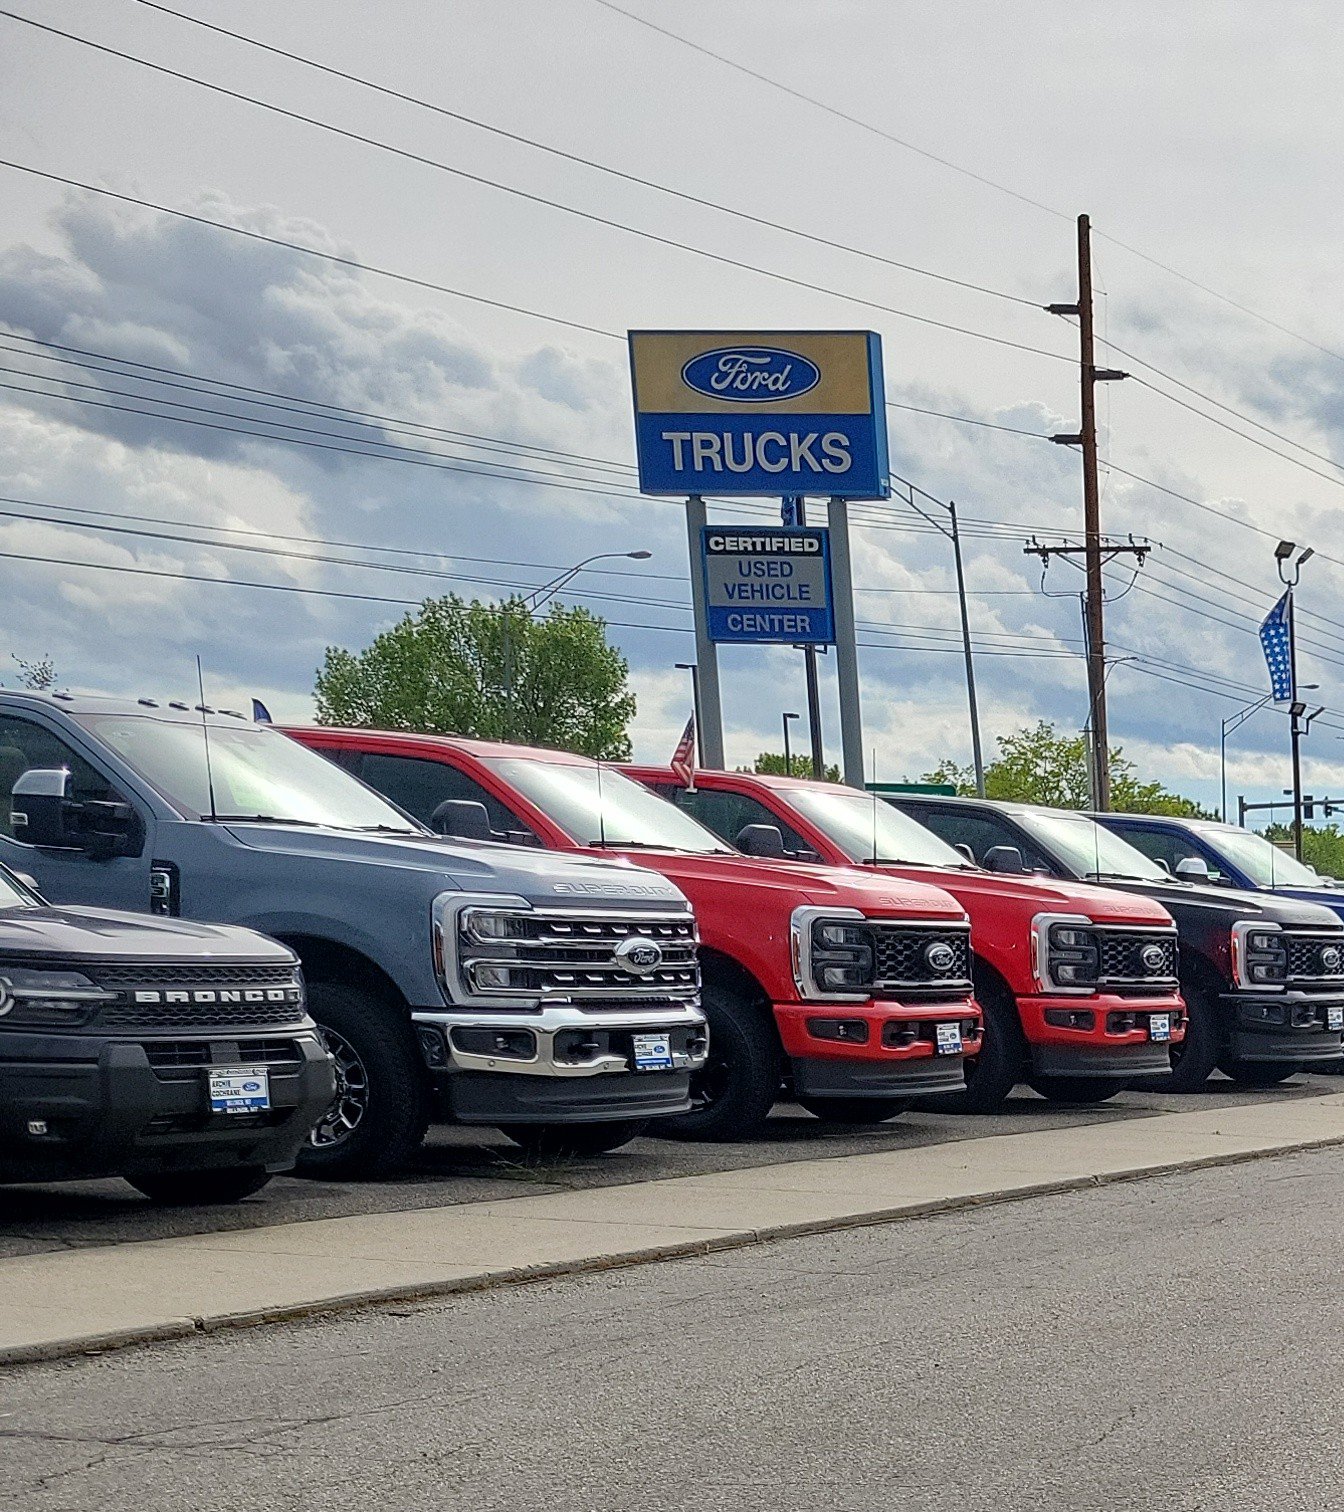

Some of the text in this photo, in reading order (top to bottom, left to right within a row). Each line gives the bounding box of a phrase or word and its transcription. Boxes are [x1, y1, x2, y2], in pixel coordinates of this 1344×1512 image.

[710, 353, 793, 392] Ford
[661, 431, 852, 473] TRUCKS
[708, 535, 819, 553] CERTIFIED
[738, 560, 793, 578] USED
[723, 582, 811, 601] VEHICLE
[726, 613, 811, 634] CENTER
[134, 989, 286, 1003] BRONCO
